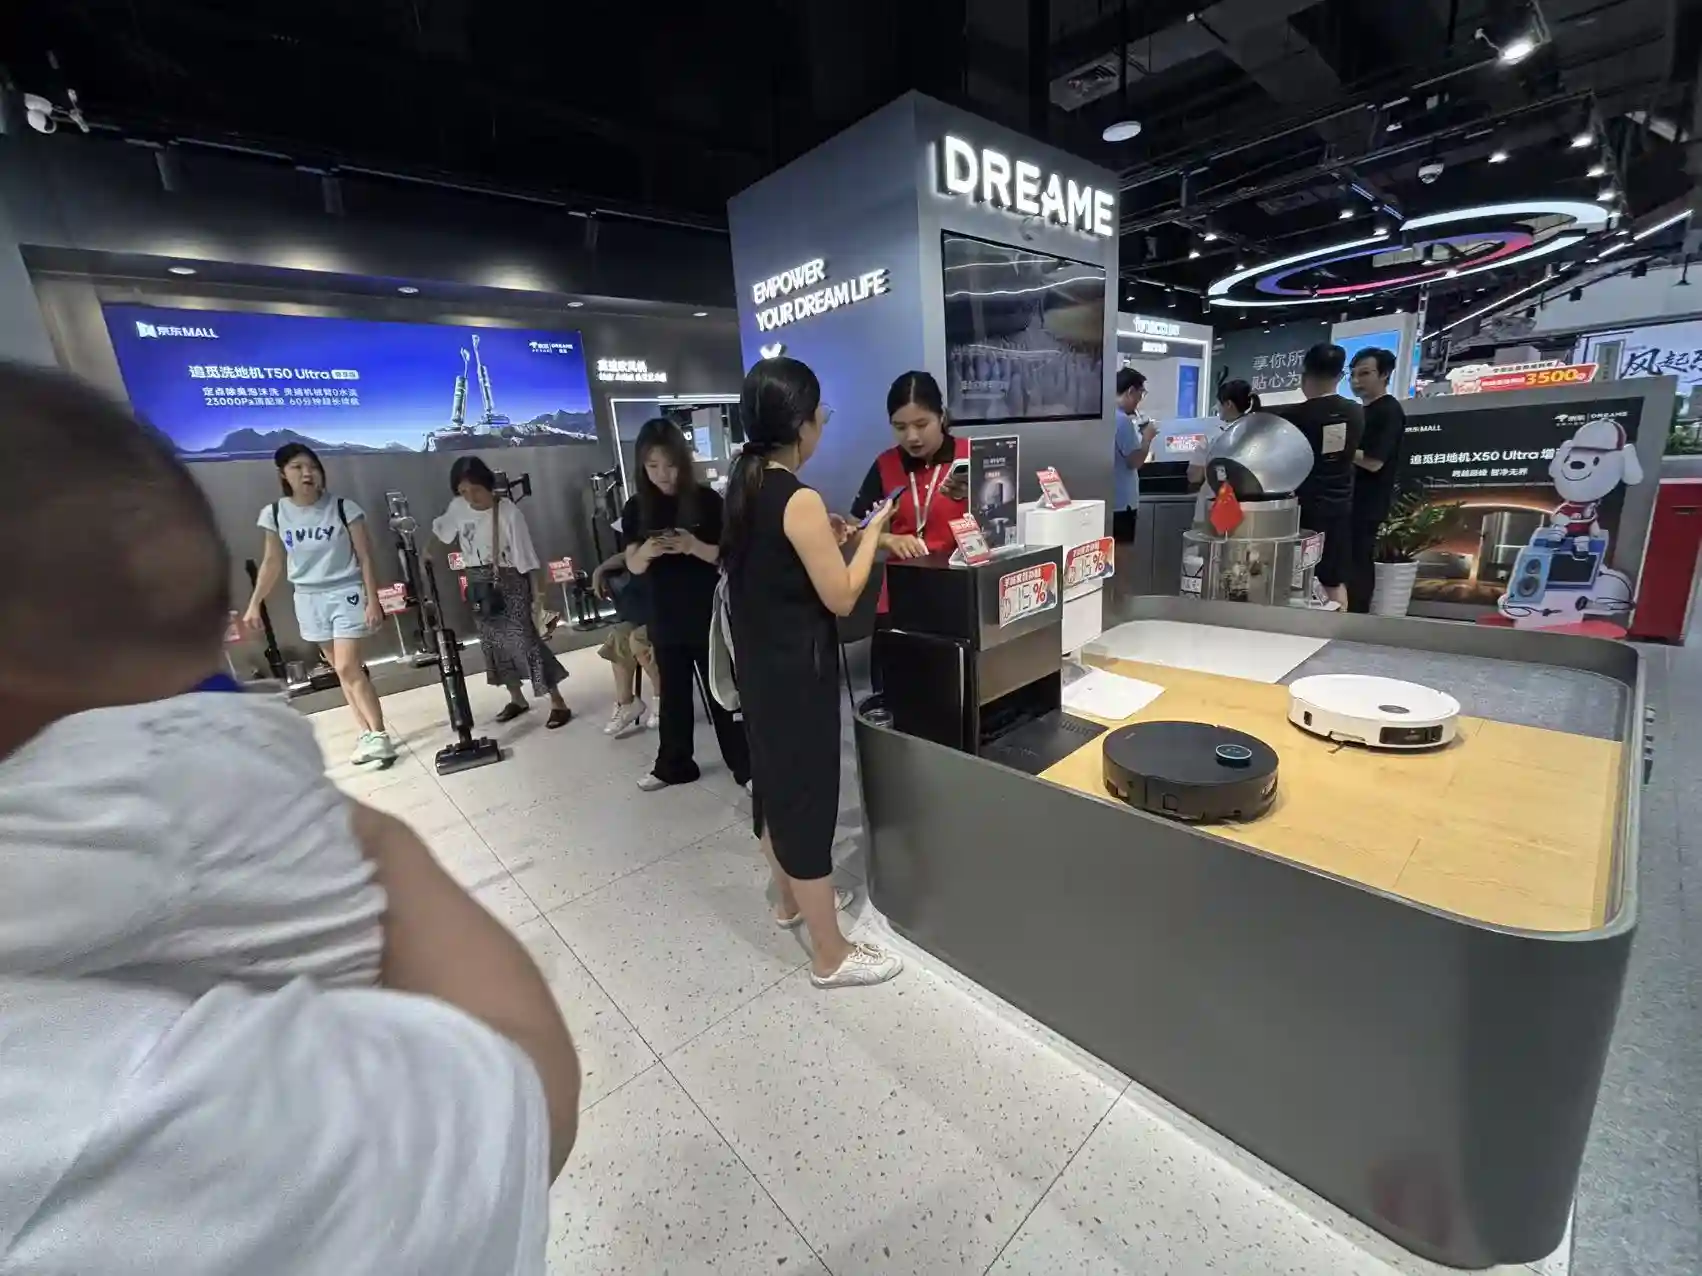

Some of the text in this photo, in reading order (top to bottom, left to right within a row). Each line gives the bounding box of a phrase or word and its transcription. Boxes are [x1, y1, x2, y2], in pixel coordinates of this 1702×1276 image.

[945, 135, 1115, 238] DREAME
[752, 258, 826, 305] EMPOWER
[756, 268, 886, 332] YOUR DREAM LIFE
[295, 368, 330, 379] Ultra
[1526, 369, 1576, 386] 3500
[1502, 452, 1539, 461] Ultra
